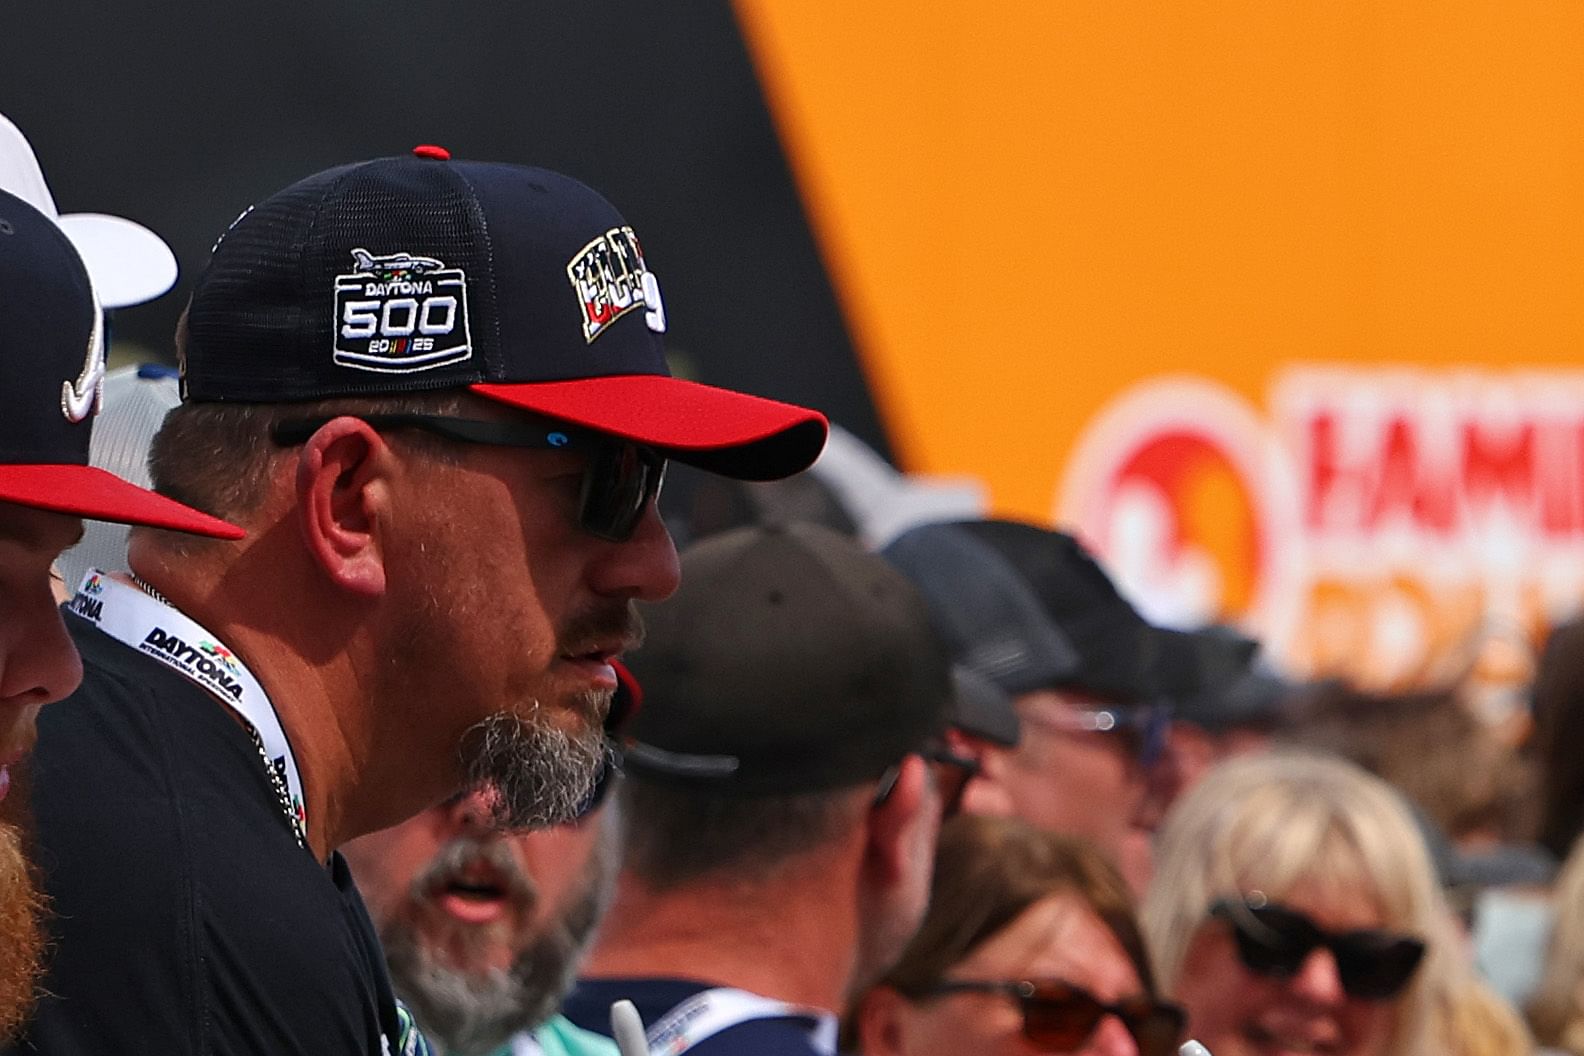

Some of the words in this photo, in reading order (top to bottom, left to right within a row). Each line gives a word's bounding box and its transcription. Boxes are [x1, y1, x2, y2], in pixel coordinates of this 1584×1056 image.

[365, 281, 433, 296] DAYTONA
[341, 296, 457, 339] 500
[139, 642, 196, 676] INTERNATIONAL
[145, 627, 244, 700] DAYTONA
